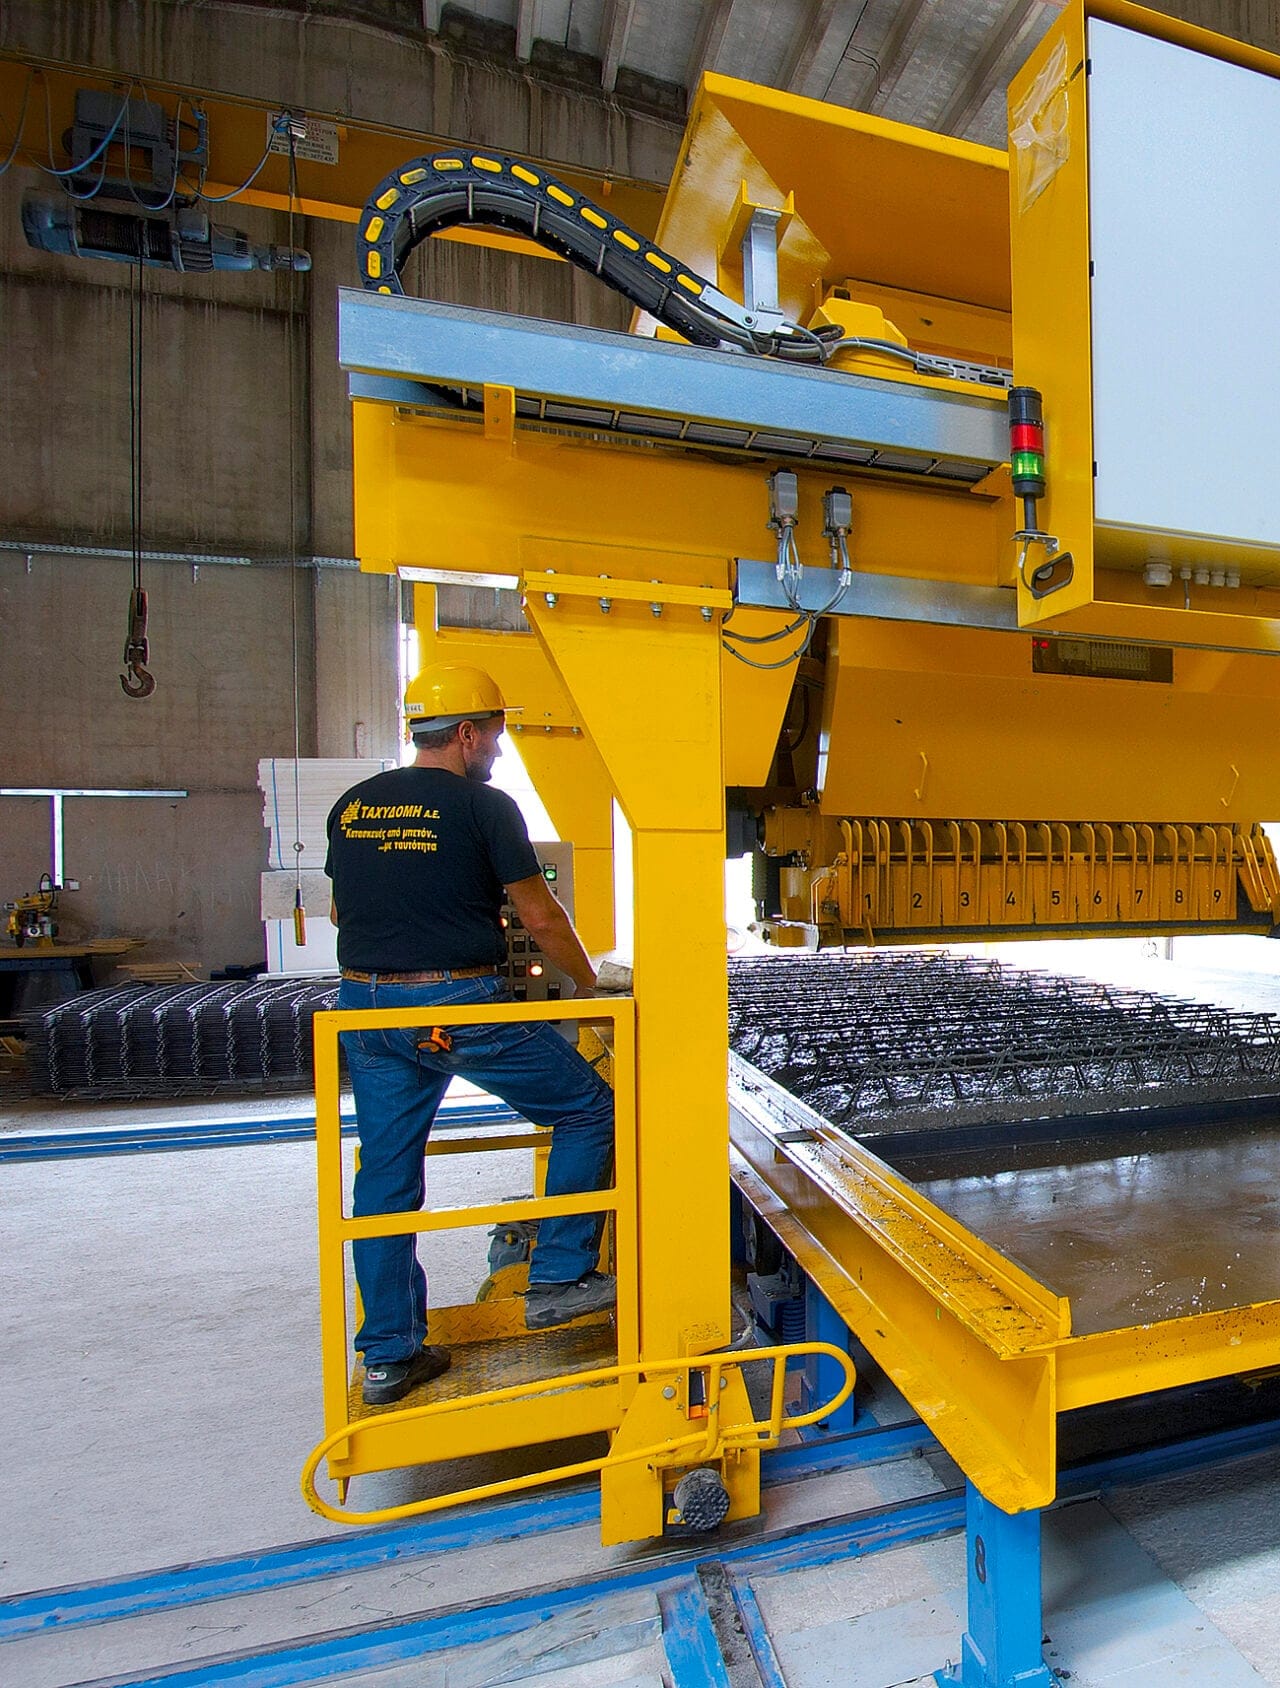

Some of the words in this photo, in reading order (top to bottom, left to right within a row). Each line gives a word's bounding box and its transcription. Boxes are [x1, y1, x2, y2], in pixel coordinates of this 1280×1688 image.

[361, 805, 423, 819] ΤΑΧΥΔΟΜΗ
[345, 827, 386, 840] Κατασκευές
[387, 826, 401, 838] από
[394, 839, 437, 853] ταυτότητα
[864, 893, 872, 909] 1
[912, 892, 923, 908] 2
[960, 891, 970, 907] 3
[1005, 891, 1016, 906] 4
[1051, 890, 1060, 905] 5
[1093, 890, 1102, 904] 6
[1135, 889, 1143, 904] 7
[1174, 889, 1183, 903] 8
[1213, 889, 1221, 903] 9
[974, 1534, 986, 1584] 8
